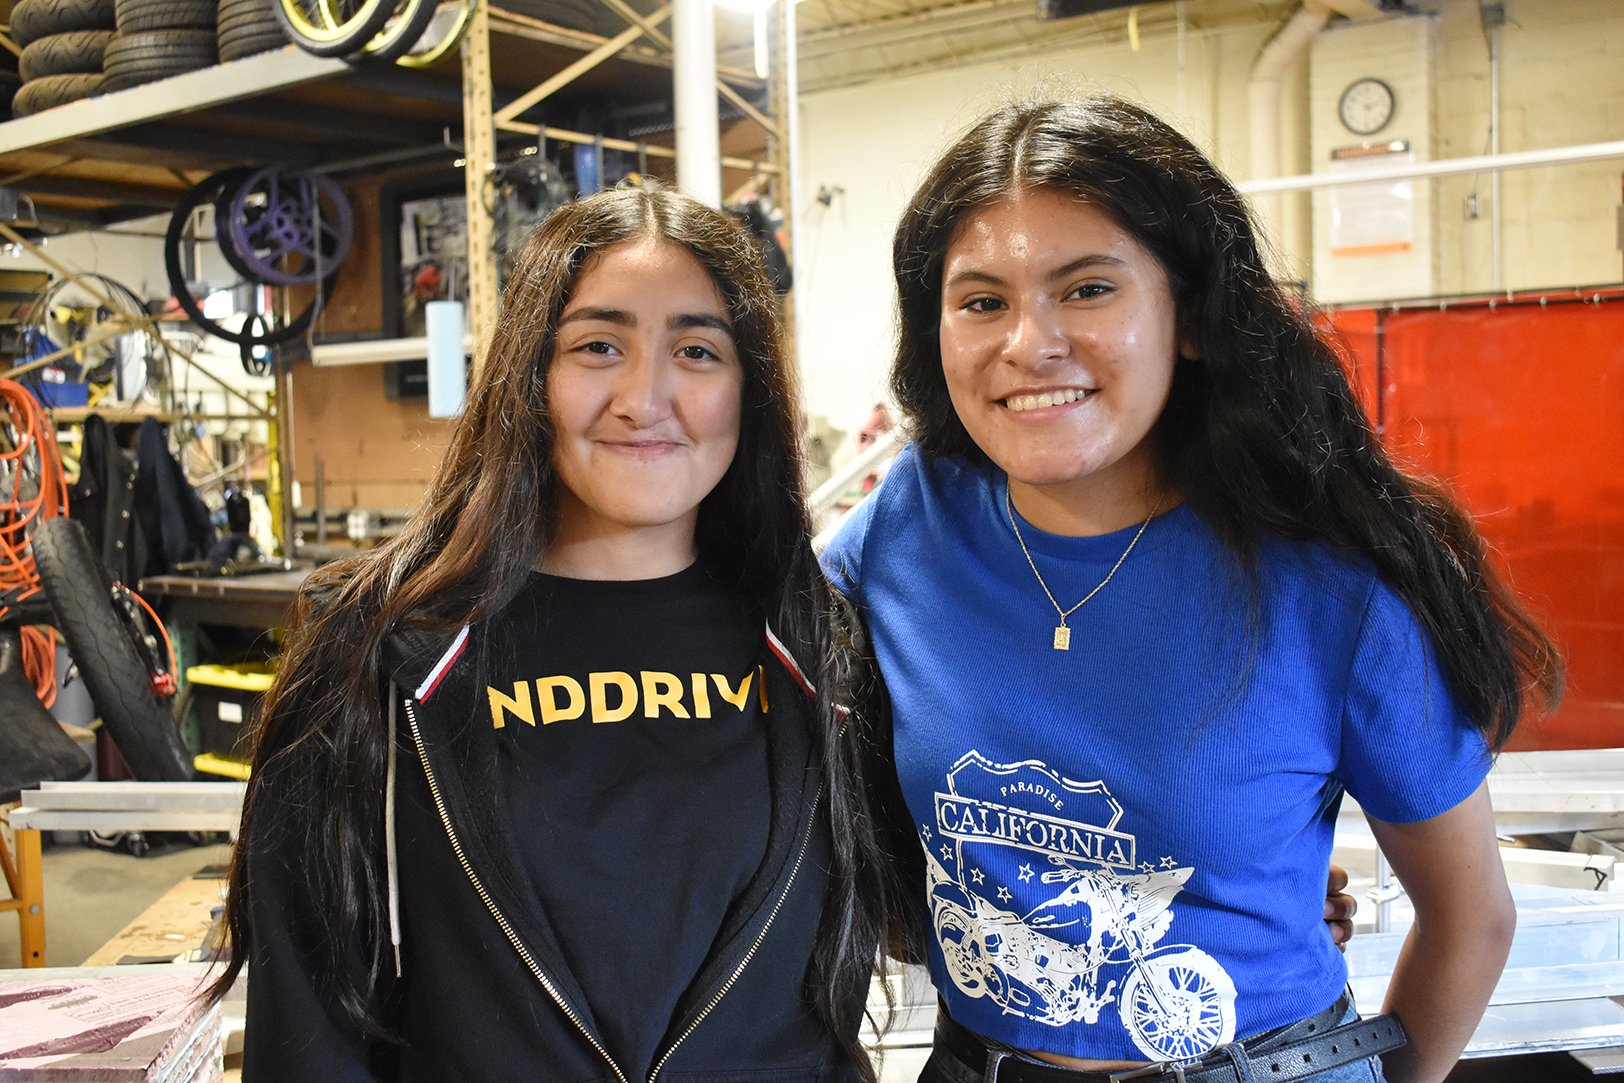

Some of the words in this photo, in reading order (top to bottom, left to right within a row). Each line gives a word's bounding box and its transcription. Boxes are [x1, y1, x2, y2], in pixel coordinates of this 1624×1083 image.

[486, 665, 769, 729] NDDRIV
[1000, 781, 1064, 811] PARADISE
[940, 802, 1130, 865] CALIFORNIA
